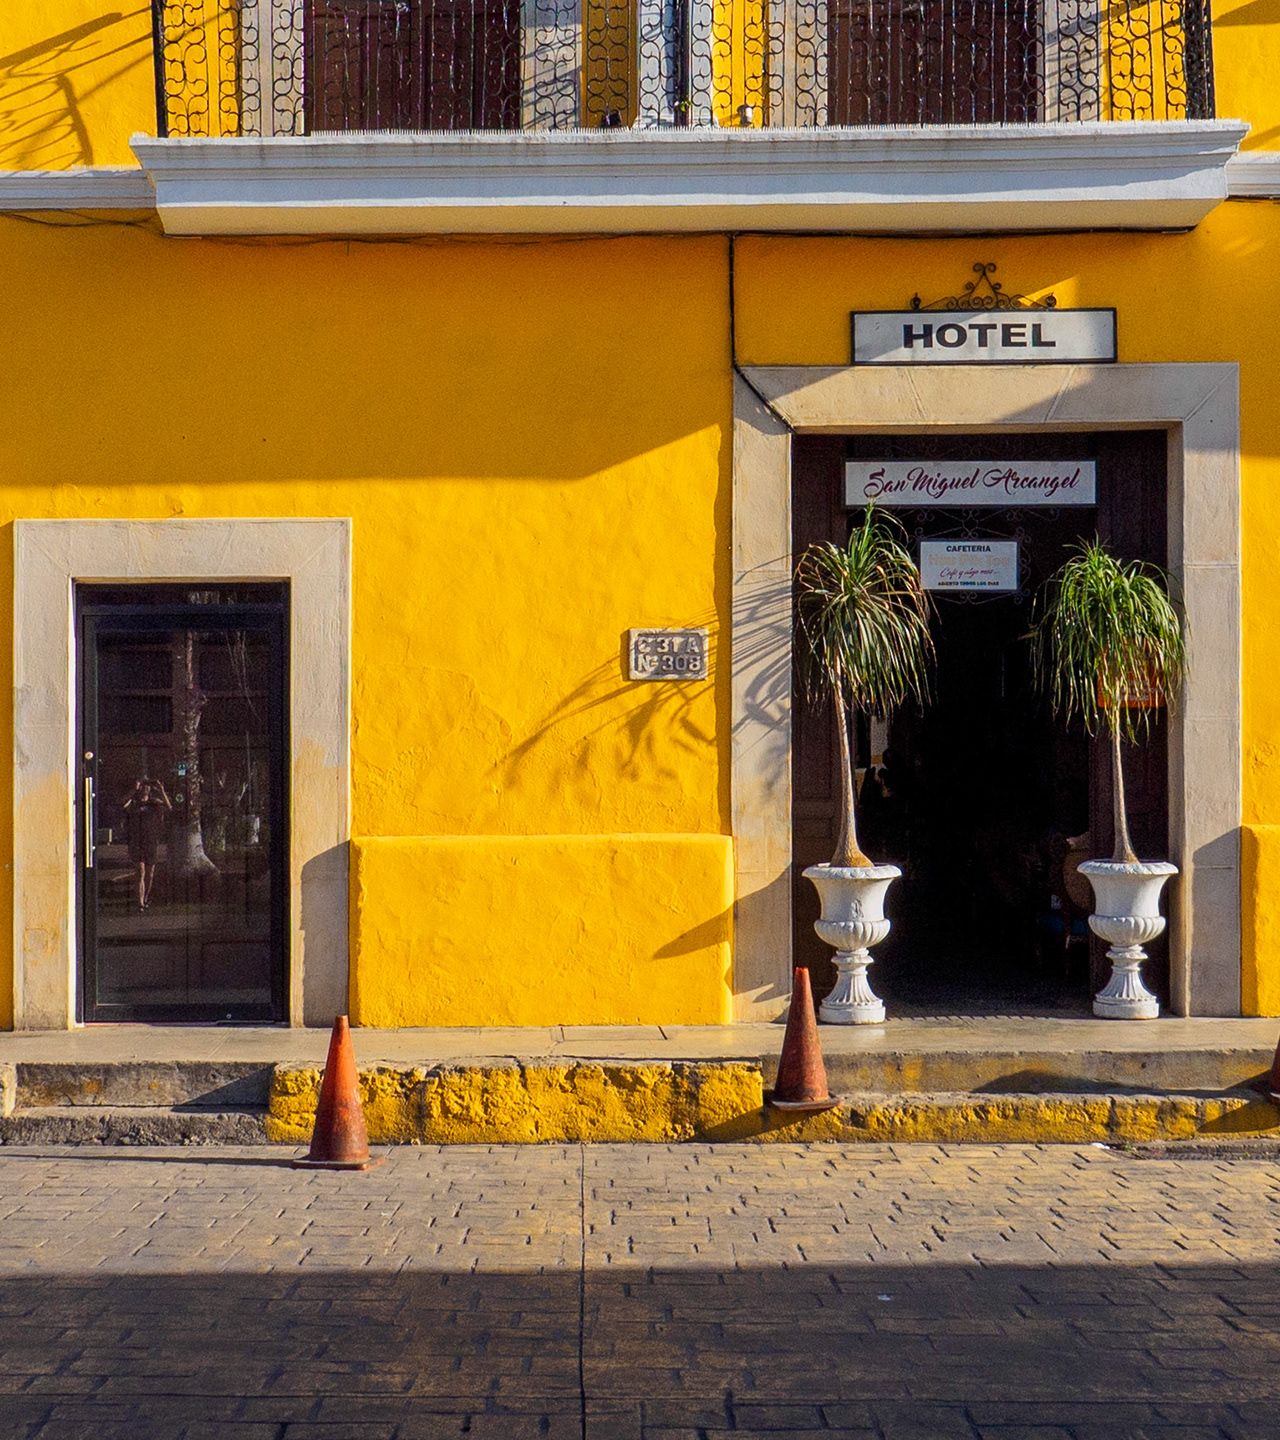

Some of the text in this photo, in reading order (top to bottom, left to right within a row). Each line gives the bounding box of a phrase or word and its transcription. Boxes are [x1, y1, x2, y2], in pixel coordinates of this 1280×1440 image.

[903, 323, 1057, 348] HOTEL
[863, 467, 1081, 499] San Miguel Arcangel
[662, 655, 701, 671] 308
